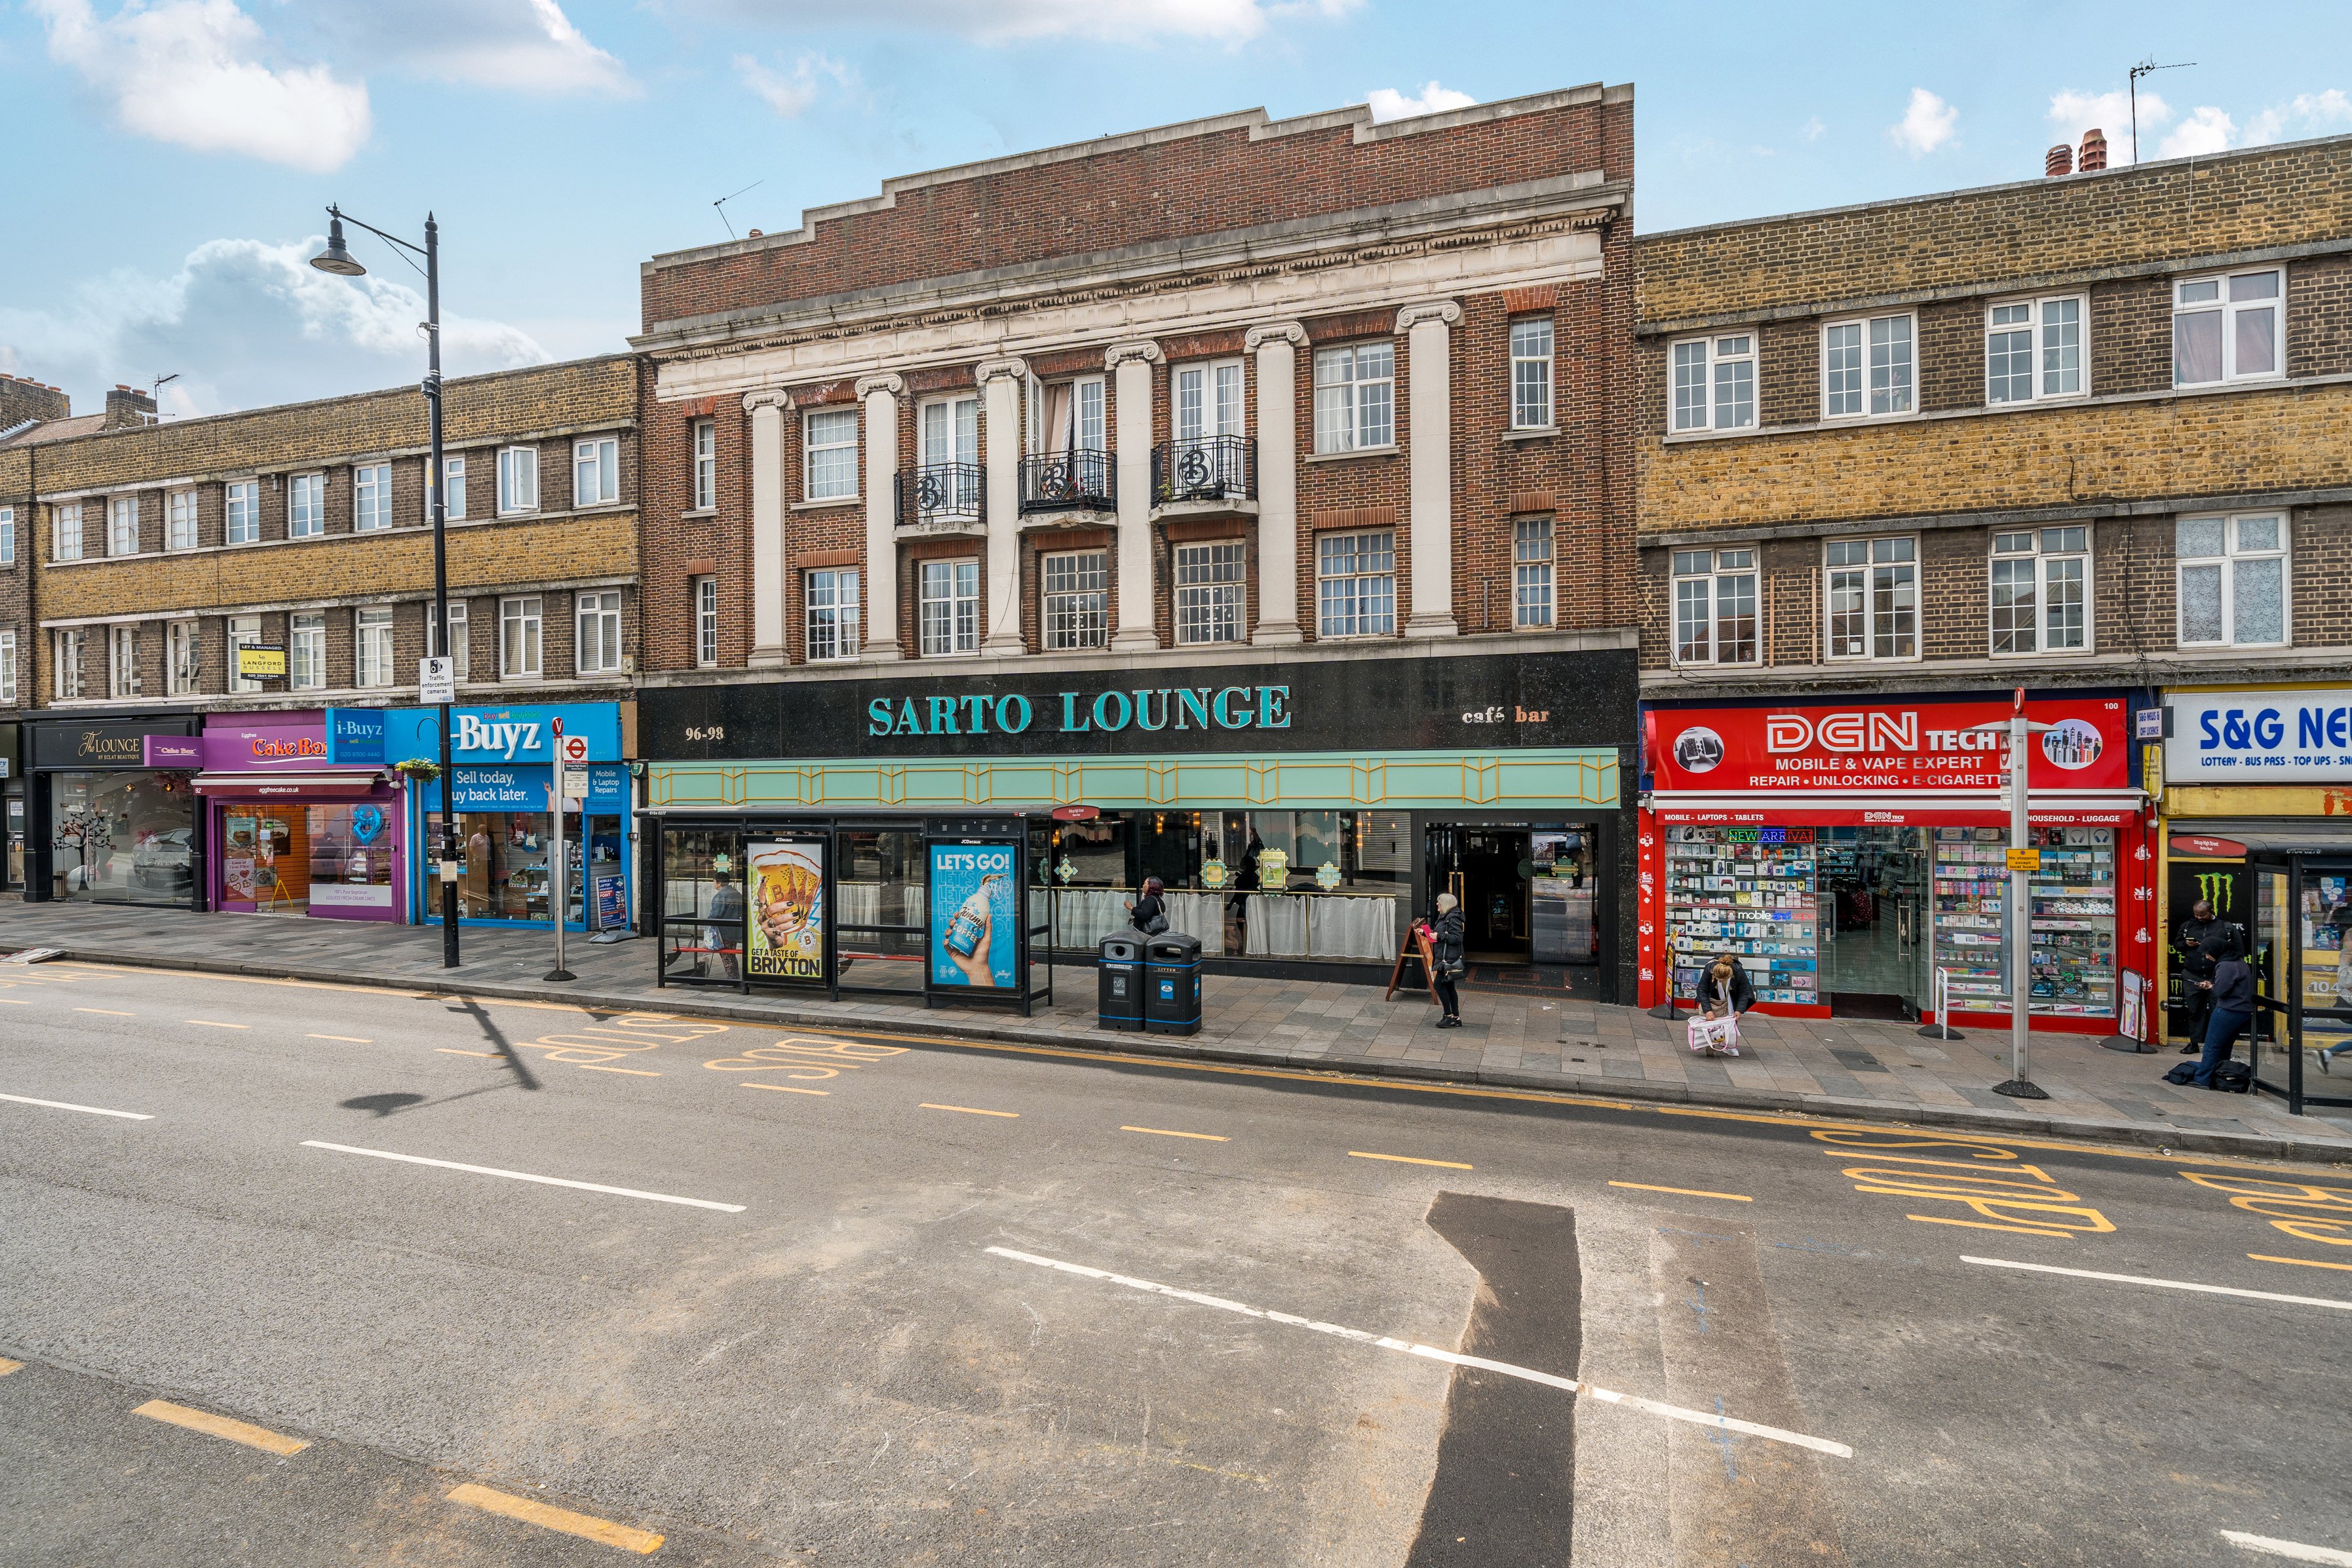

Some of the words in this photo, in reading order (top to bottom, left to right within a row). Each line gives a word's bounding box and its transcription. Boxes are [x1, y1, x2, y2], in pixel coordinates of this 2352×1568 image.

[484, 712, 496, 721] buy
[511, 710, 541, 720] buyback
[868, 693, 1034, 736] SARTO
[1058, 685, 1293, 733] LOUNGE
[1461, 706, 1505, 725] café
[1514, 706, 1551, 723] bar
[337, 720, 383, 738] i-Buyz
[685, 727, 724, 740] 96-98
[1767, 711, 1919, 753] DGN
[1925, 729, 1996, 751] TECH
[2147, 726, 2159, 735] LICENCE
[2200, 708, 2285, 750] S&G
[2298, 707, 2352, 749] NE
[78, 730, 103, 757] The
[96, 738, 140, 753] LOUNGE
[439, 715, 541, 760] -Buyz
[252, 738, 298, 756] Cake
[1775, 757, 1840, 771] MOBILE
[1844, 757, 1857, 770] &
[1862, 757, 1907, 769] VAPE
[1913, 756, 1984, 769] EXPERT
[2201, 756, 2237, 767] LOTTERY
[2245, 756, 2262, 766] BUS
[2264, 756, 2286, 766] PASS
[2294, 756, 2311, 766] TOP
[2314, 756, 2330, 765] UPS
[2339, 755, 2352, 765] SN
[457, 771, 476, 784] Sell
[480, 771, 515, 786] today,
[1749, 776, 1800, 786] REPAIR
[1813, 775, 1899, 786] UNLOCKING
[452, 791, 466, 804] uy
[469, 788, 497, 801] back
[499, 788, 528, 801] later.
[2082, 814, 2120, 823] LUGGAGE
[1729, 832, 1756, 841] NEW
[937, 854, 974, 870] LET'S
[976, 854, 1009, 870] GO!
[1738, 910, 1771, 920] mobile
[1772, 911, 1791, 920] and
[1792, 913, 1815, 921] vape
[953, 923, 978, 944] COFFEE
[751, 956, 820, 976] BRIXTON
